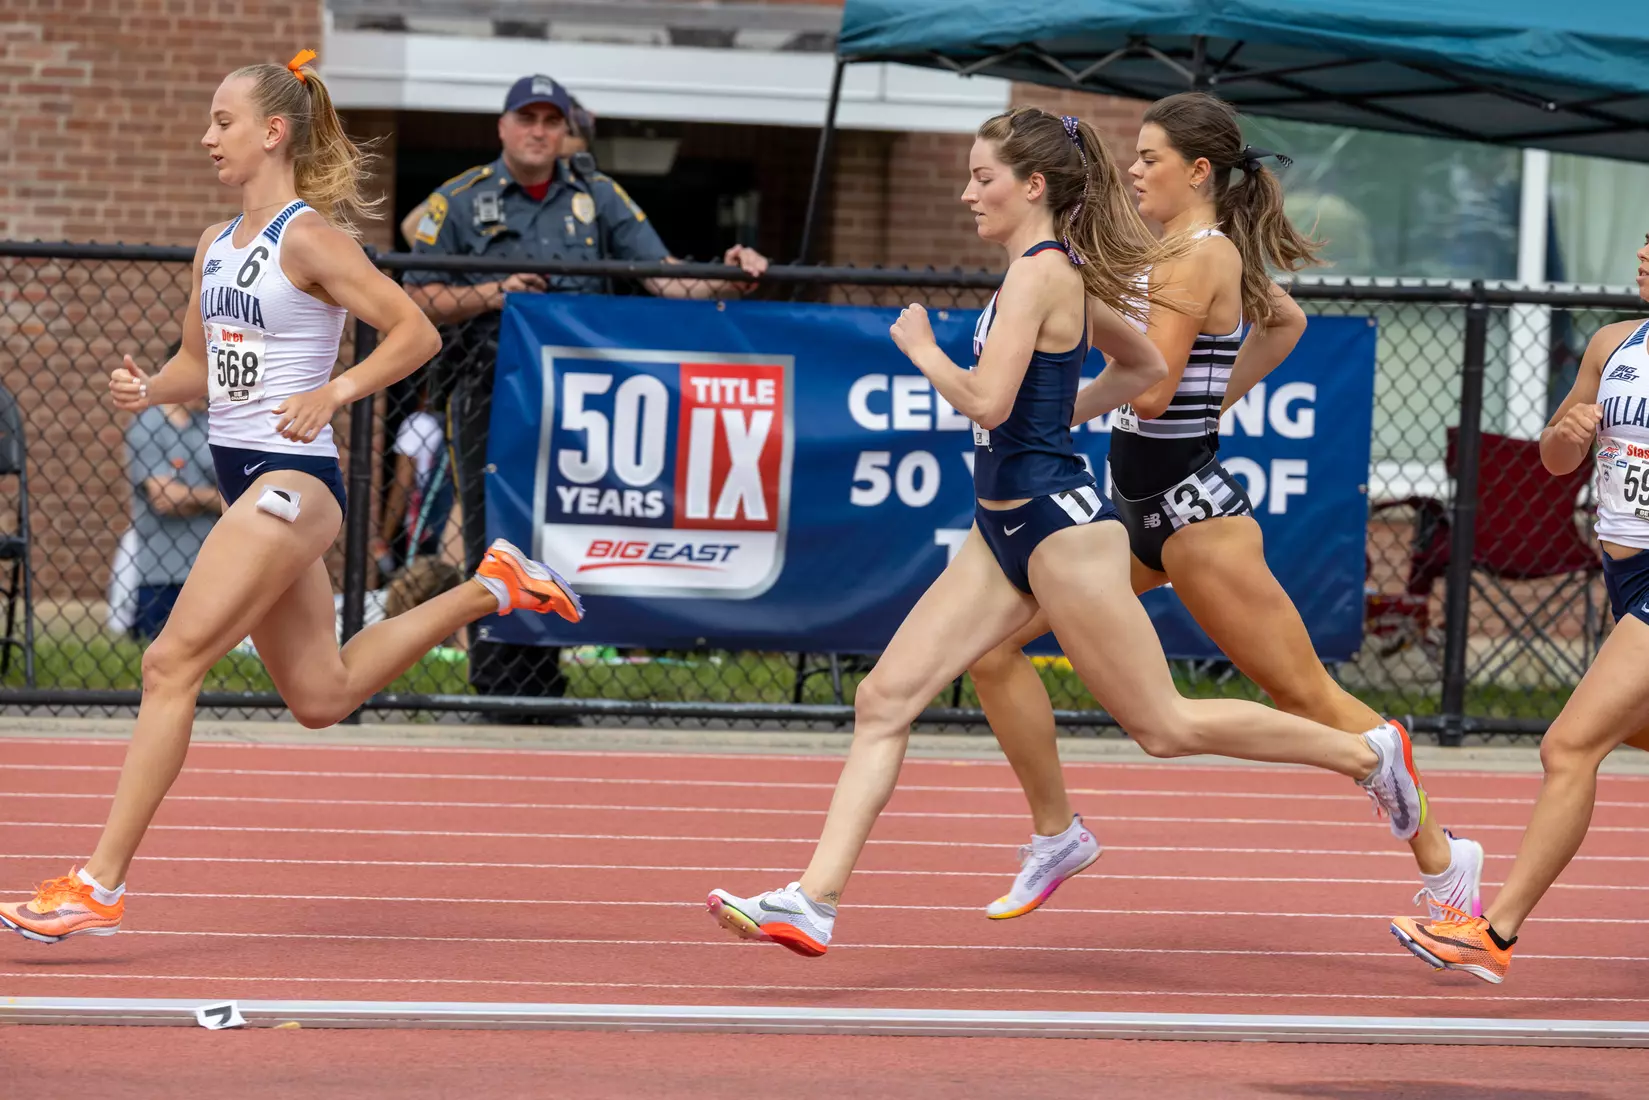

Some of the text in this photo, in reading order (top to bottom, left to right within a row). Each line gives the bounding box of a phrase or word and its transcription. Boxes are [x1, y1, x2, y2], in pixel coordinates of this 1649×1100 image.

[236, 245, 269, 289] 6
[217, 349, 259, 388] 568
[1609, 371, 1640, 381] EAST
[1615, 364, 1637, 373] BIG
[690, 376, 775, 405] TITLE
[557, 372, 670, 487] 50
[1600, 396, 1649, 431] VILLA
[685, 408, 775, 521] IX
[849, 450, 941, 508] 50
[1220, 457, 1307, 514] OF
[556, 487, 665, 518] YEARS
[1173, 482, 1214, 524] 3
